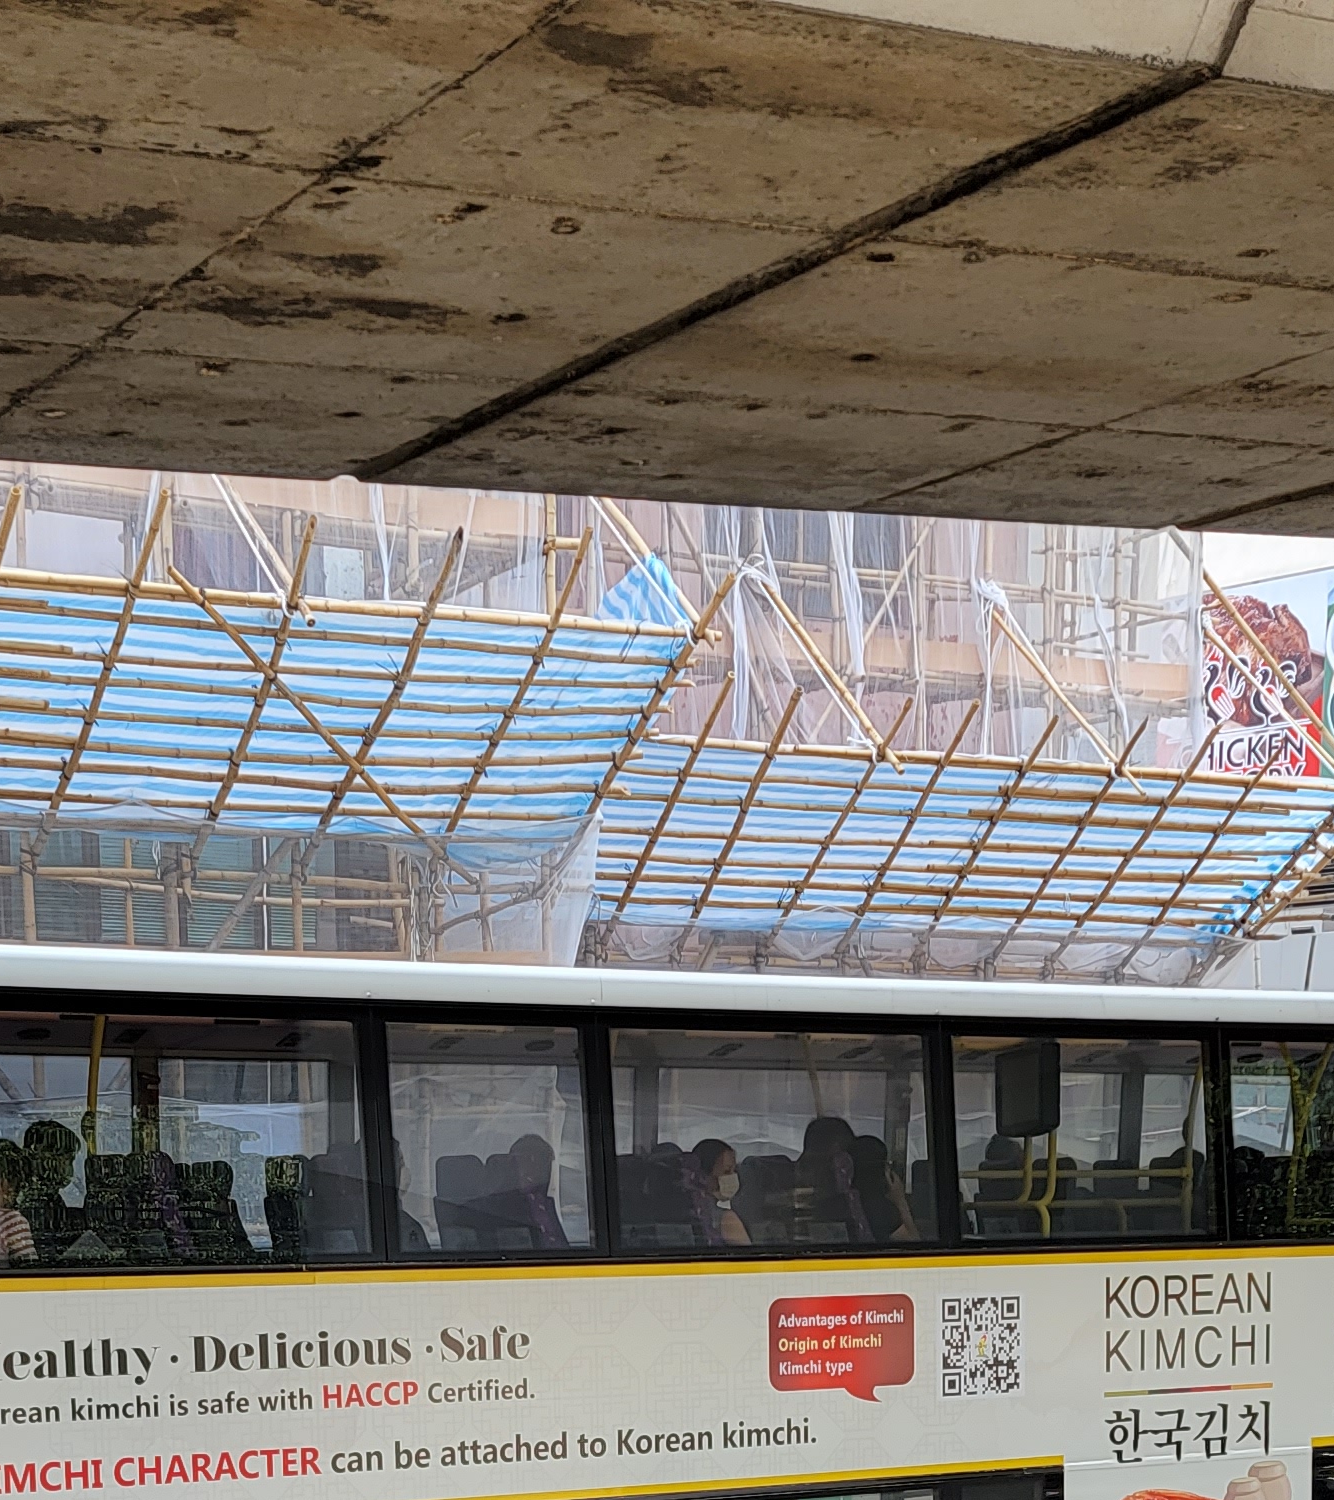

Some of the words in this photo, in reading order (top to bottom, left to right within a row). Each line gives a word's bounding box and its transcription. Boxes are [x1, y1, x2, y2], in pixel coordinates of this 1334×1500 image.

[1105, 1271, 1272, 1319] KOREAN
[778, 1313, 847, 1330] Advantages
[849, 1311, 863, 1325] of
[865, 1309, 904, 1324] Kimchi
[188, 1331, 412, 1375] Delicious
[778, 1336, 818, 1354] Origin
[822, 1335, 836, 1350] of
[840, 1333, 882, 1349] Kimchi
[1105, 1323, 1271, 1373] KIMCHI
[779, 1359, 822, 1376] Kimchi
[825, 1361, 853, 1377] type
[70, 1394, 159, 1421] kimchi
[169, 1393, 189, 1417] is
[197, 1390, 250, 1415] safe
[258, 1387, 313, 1412] with
[322, 1381, 418, 1409] HACCP
[427, 1377, 536, 1403] Certified.
[113, 1447, 323, 1487] CHARACTER
[331, 1450, 384, 1474] can
[394, 1440, 431, 1470] be
[440, 1431, 568, 1467] attached
[577, 1433, 607, 1458] to
[617, 1428, 713, 1455] Korean
[722, 1417, 818, 1449] kimchi.
[1104, 1400, 1271, 1464] 한국김치
